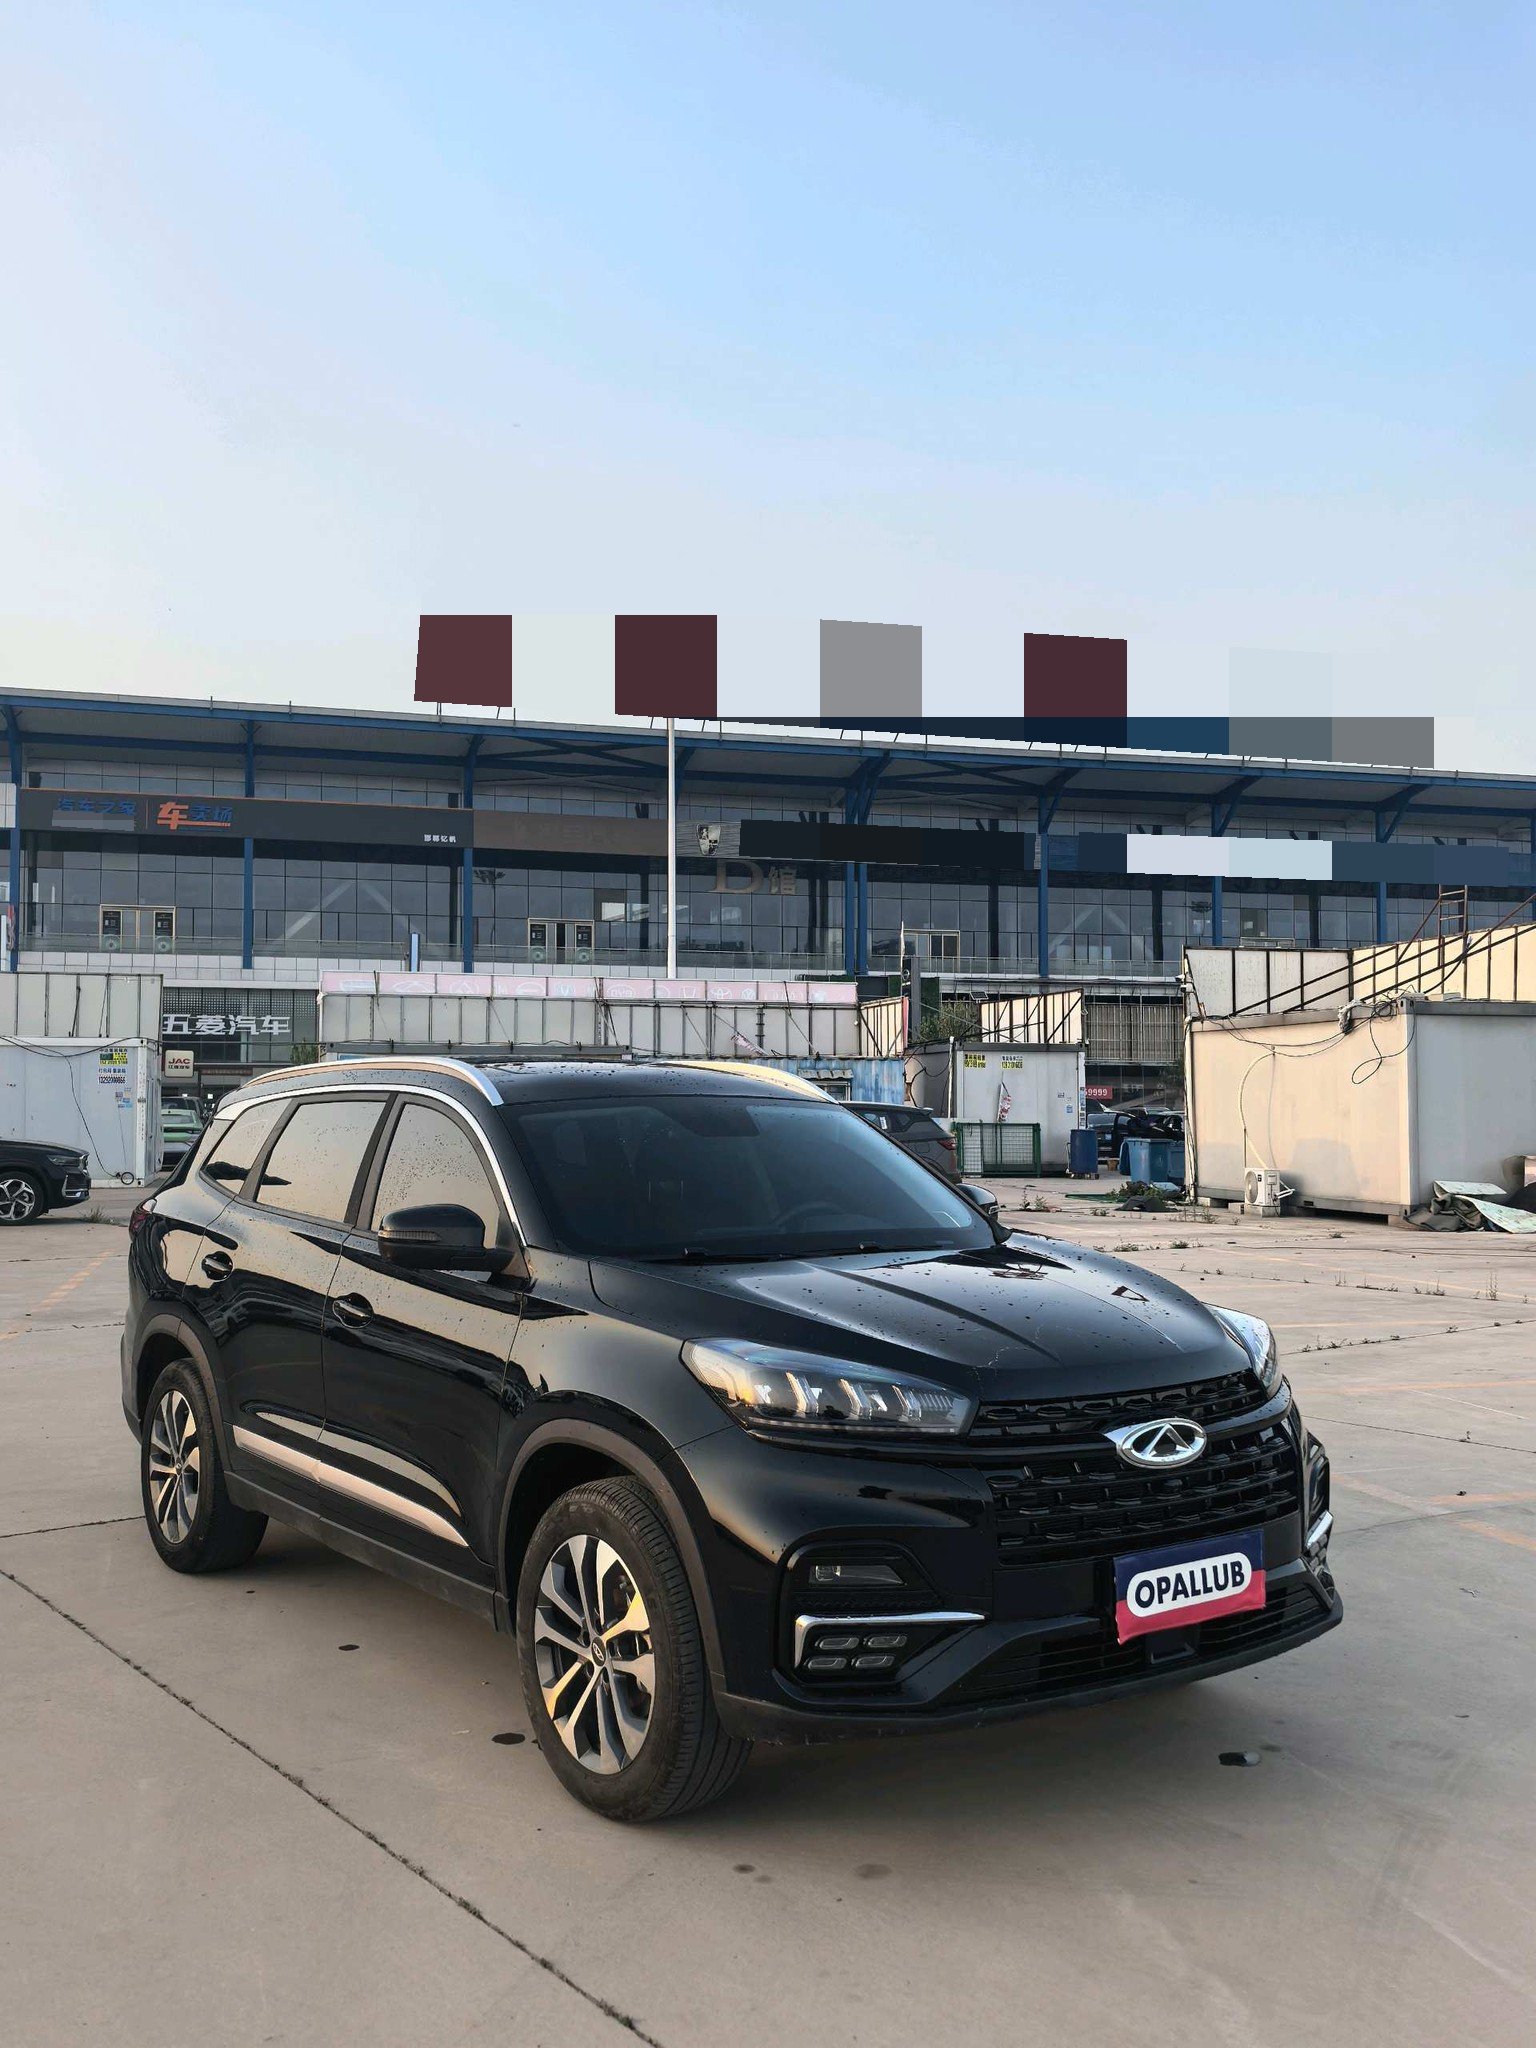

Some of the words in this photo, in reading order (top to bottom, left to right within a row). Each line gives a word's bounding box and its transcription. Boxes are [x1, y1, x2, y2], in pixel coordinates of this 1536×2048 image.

[162, 1013, 291, 1035] 五菱汽车
[1135, 1561, 1245, 1608] OPALLUB
